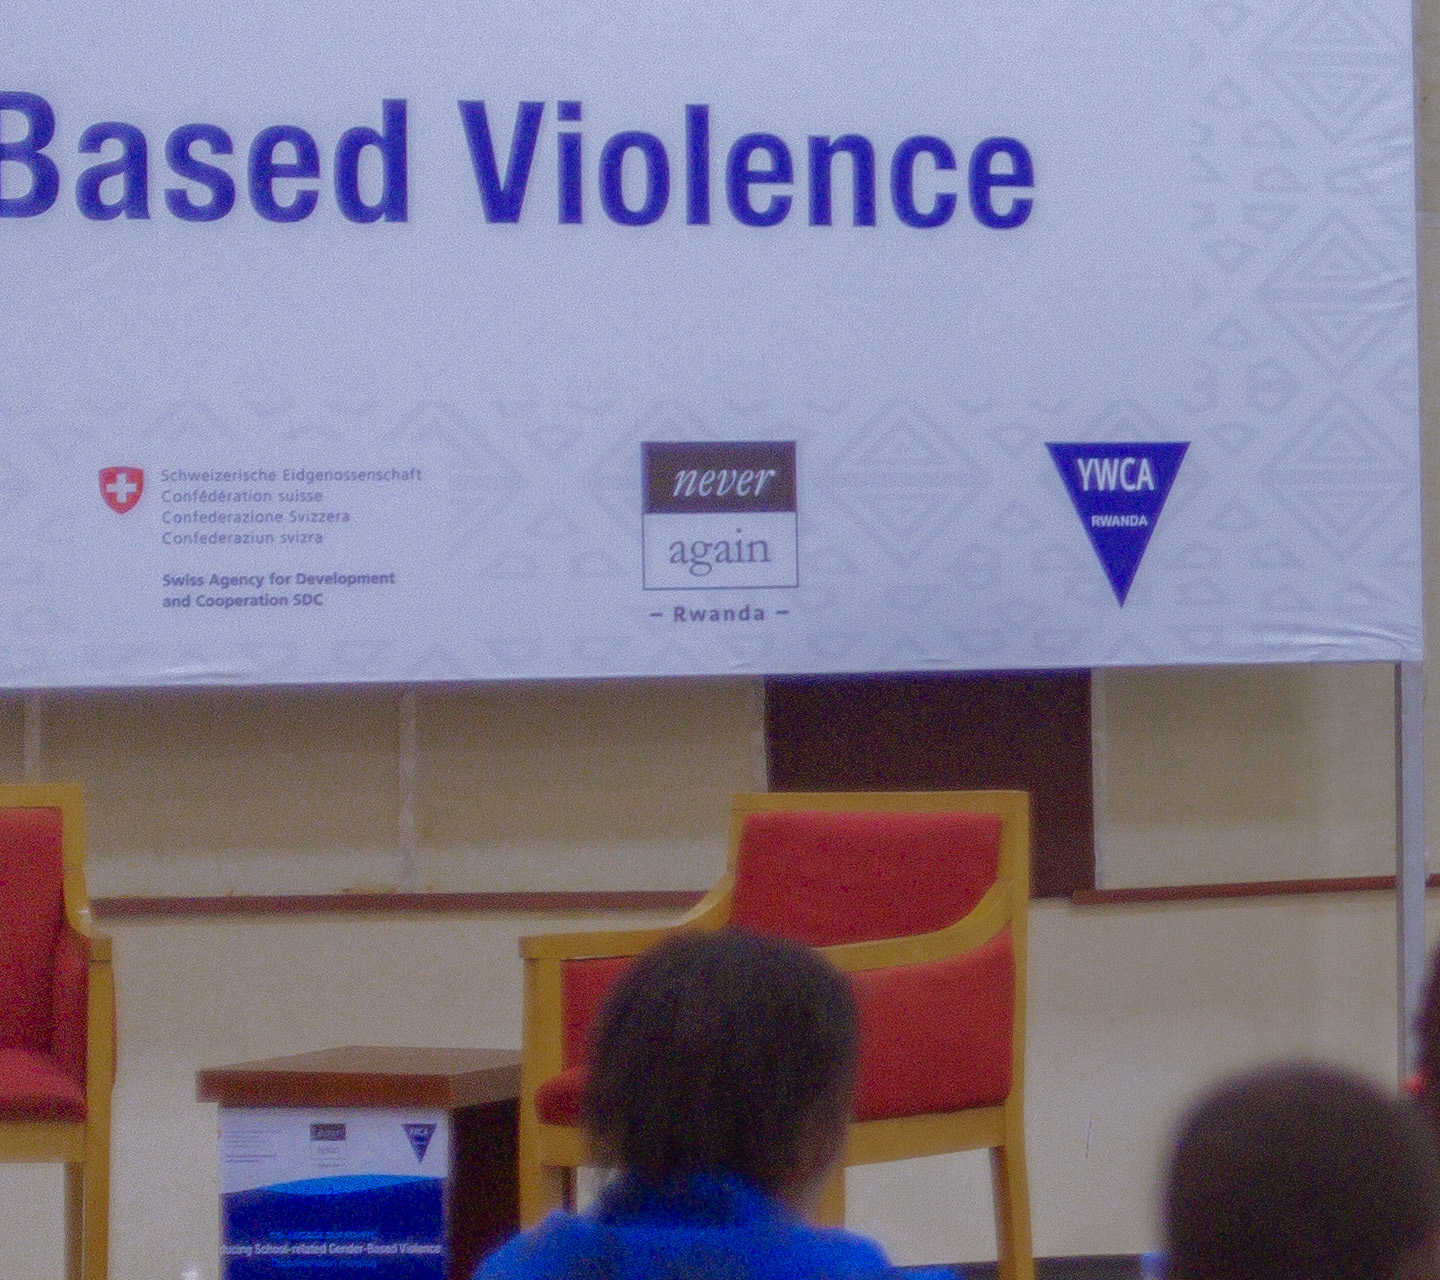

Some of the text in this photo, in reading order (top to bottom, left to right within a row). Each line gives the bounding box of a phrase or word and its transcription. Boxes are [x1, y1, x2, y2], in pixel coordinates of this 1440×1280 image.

[0, 90, 1035, 230] Based Violence
[160, 468, 422, 485] Schweizerische Eidgenossenschaft
[1076, 456, 1155, 492] YWCA
[672, 468, 777, 498] never
[278, 489, 324, 504] suisse
[161, 509, 351, 524] Confederazione Svizzera
[1090, 514, 1149, 528] RWANDA
[161, 531, 324, 545] Confederaziun svizra
[669, 527, 772, 577] again
[162, 571, 397, 589] Swiss Agency for Development
[162, 592, 325, 609] and Cooperation SDC
[673, 603, 765, 622] Rwanda
